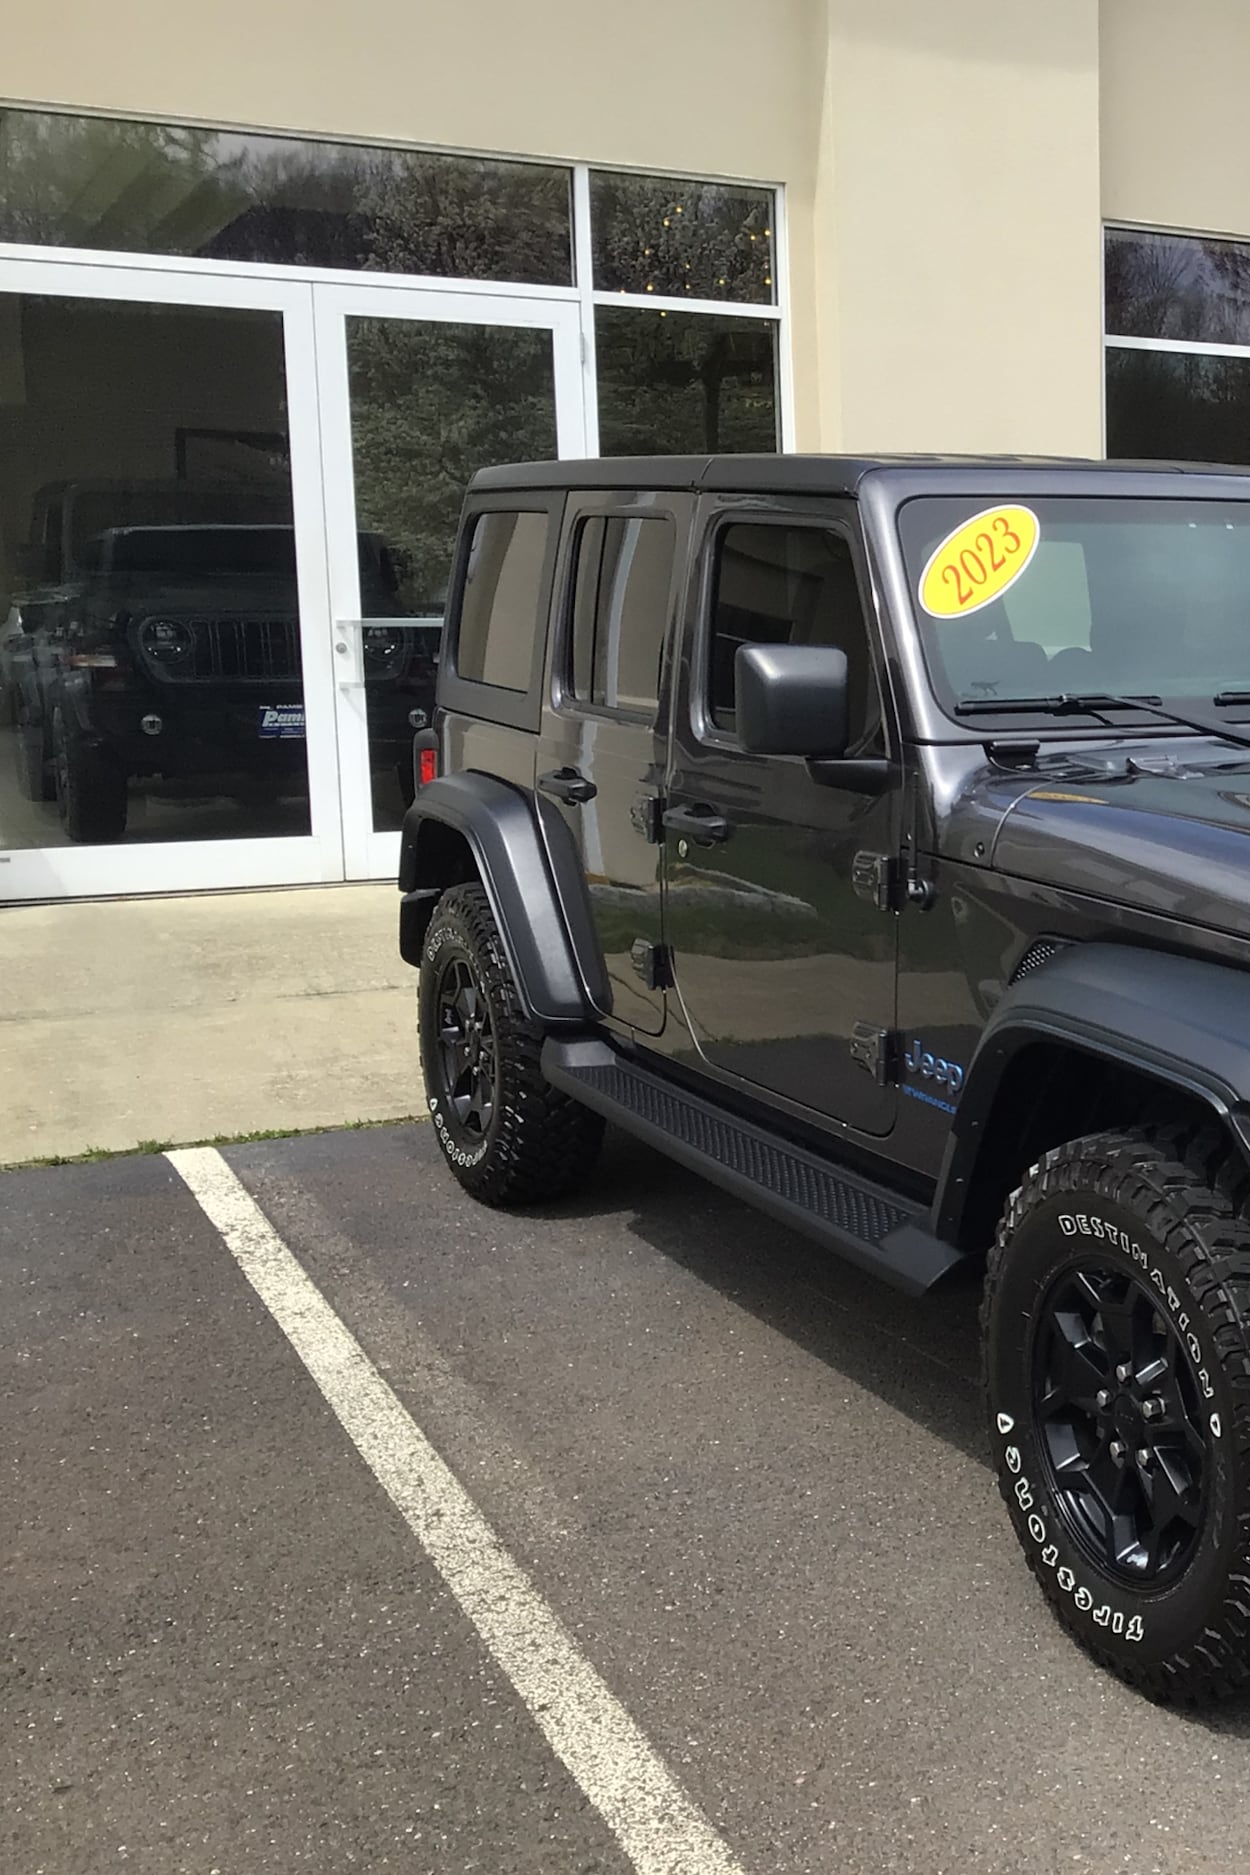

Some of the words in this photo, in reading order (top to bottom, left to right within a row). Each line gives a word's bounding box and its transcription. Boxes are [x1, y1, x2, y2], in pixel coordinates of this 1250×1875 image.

[941, 517, 1021, 605] 2023
[262, 710, 304, 727] Pam
[904, 1040, 964, 1096] Jeep
[1058, 1213, 1214, 1398] DESTINATION
[1006, 1445, 1144, 1642] Firestone
